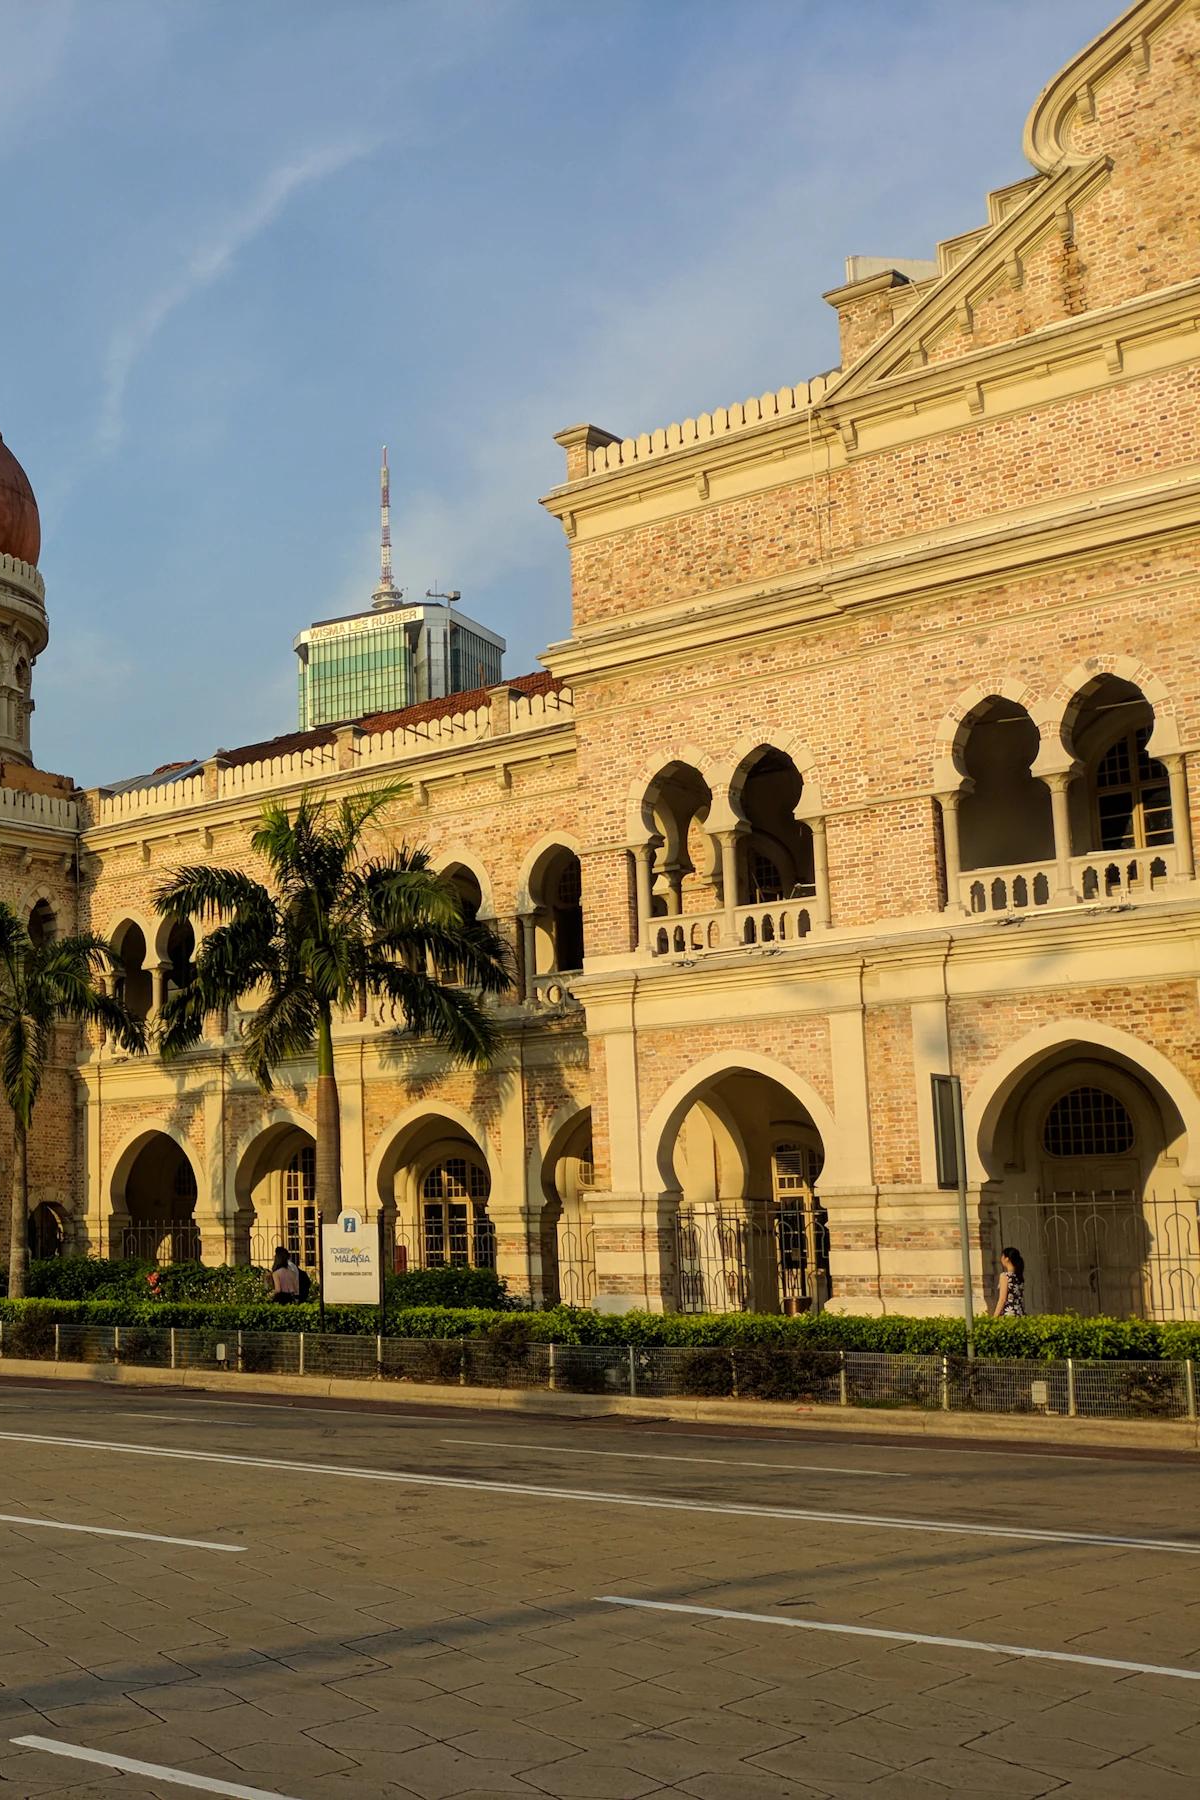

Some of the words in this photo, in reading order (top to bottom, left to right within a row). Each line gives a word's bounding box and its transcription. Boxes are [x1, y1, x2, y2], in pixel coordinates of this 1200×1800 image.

[309, 624, 346, 640] WISMA
[348, 620, 368, 631] LEE
[371, 609, 417, 628] RUBBER
[334, 1254, 370, 1264] MALAYSIA
